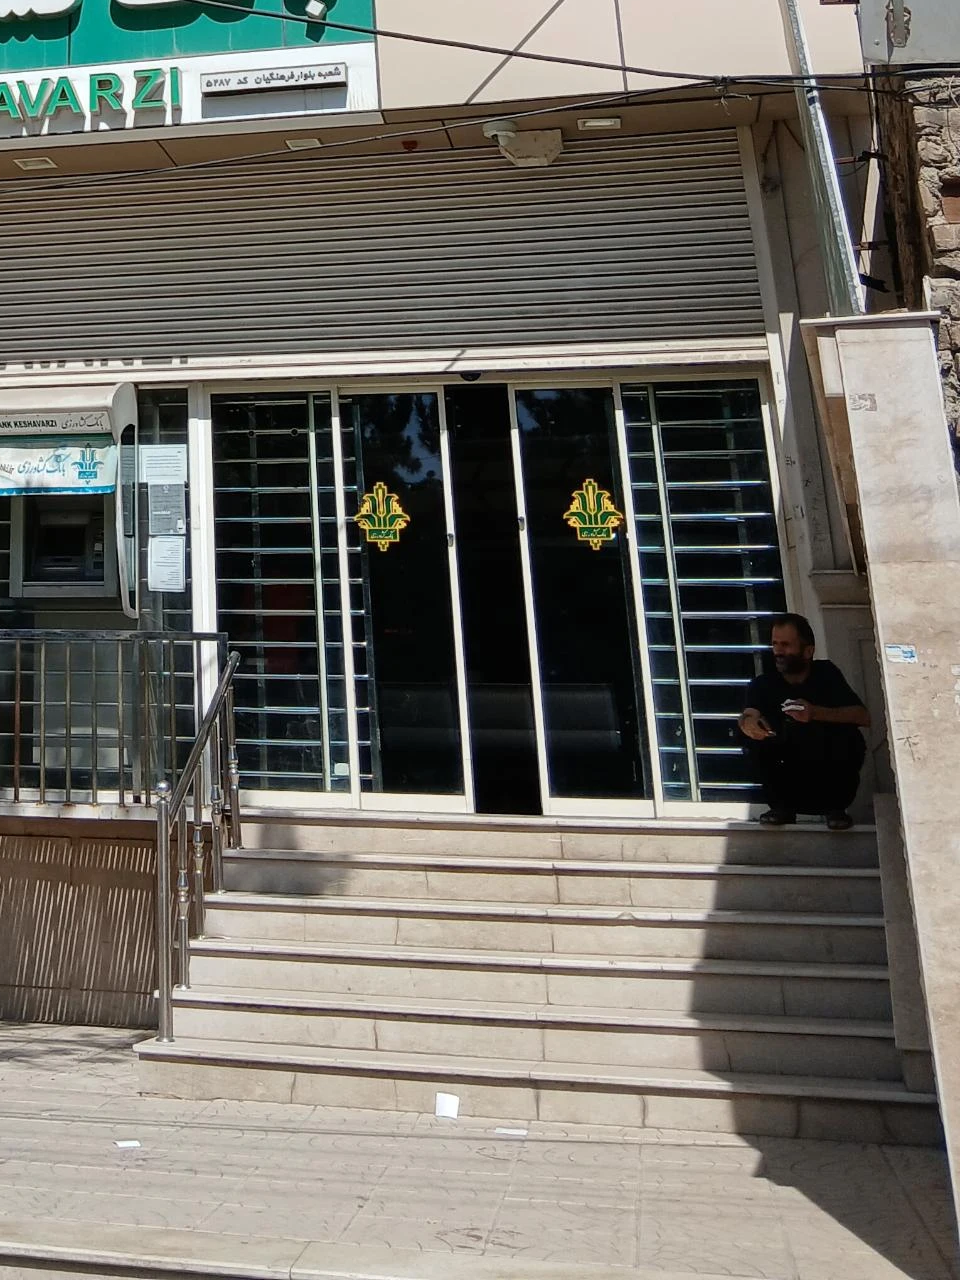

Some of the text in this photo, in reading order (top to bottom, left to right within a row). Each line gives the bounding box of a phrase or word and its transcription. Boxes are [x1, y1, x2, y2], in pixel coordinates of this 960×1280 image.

[317, 66, 342, 80] شعبه
[236, 76, 249, 85] کد
[13, 419, 58, 429] KESHAVARZI
